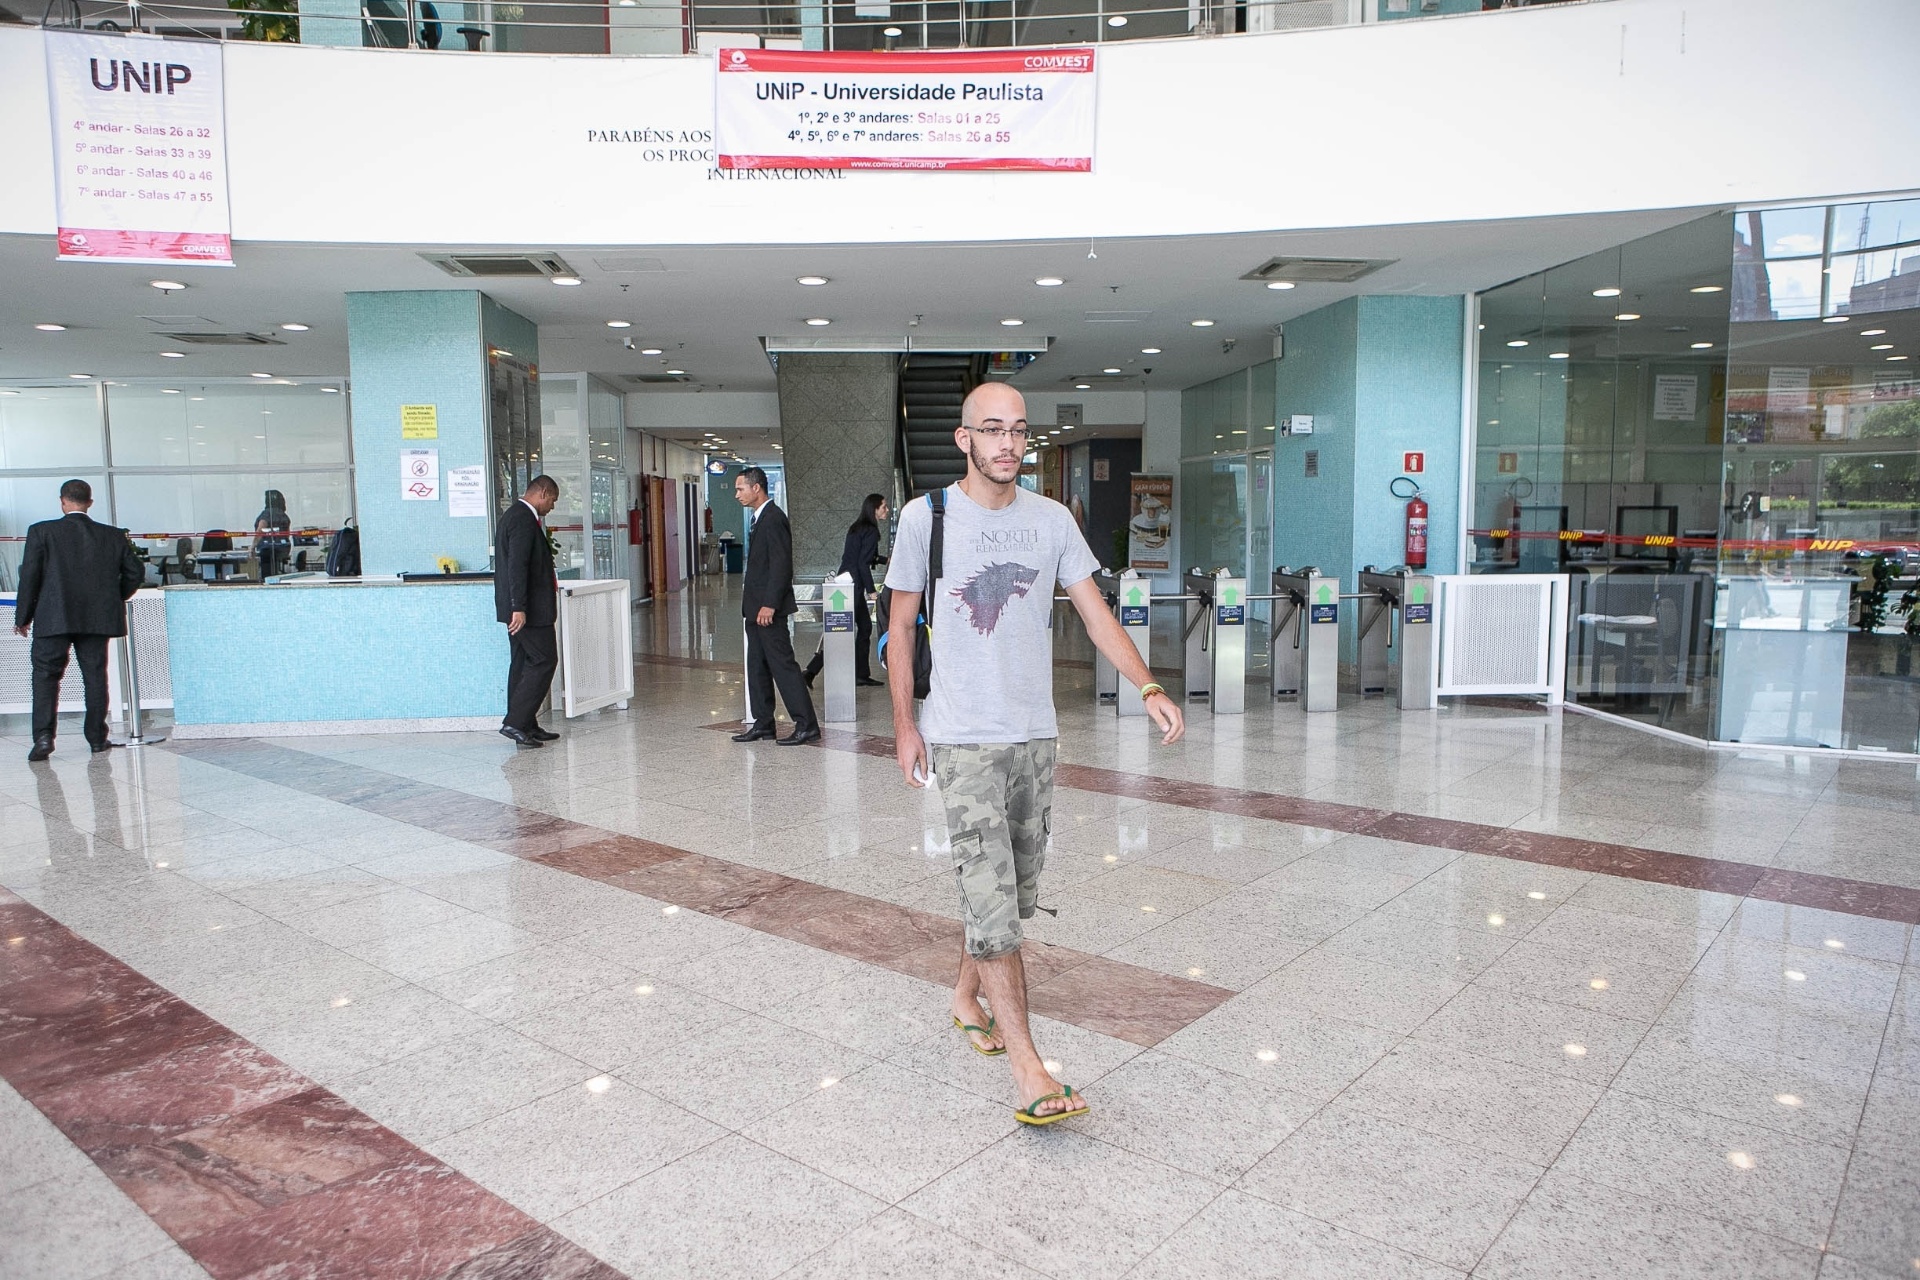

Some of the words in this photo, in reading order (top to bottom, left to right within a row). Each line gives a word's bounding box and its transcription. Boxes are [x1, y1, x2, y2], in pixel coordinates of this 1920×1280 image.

[1024, 56, 1090, 67] COMVEST
[90, 58, 192, 95] UNIP
[756, 82, 804, 100] UNIP
[824, 82, 956, 100] Universidade
[962, 82, 1044, 100] Paulista
[798, 112, 813, 125] 1º,
[816, 112, 829, 123] 2º
[832, 114, 840, 123] e
[843, 112, 856, 123] 3º
[859, 112, 914, 124] andares:
[918, 112, 952, 124] Salas
[956, 113, 970, 124] 01
[974, 115, 982, 124] a
[986, 113, 1000, 124] 25
[74, 120, 85, 130] 4º
[88, 122, 124, 133] andar
[134, 124, 166, 136] Salas
[170, 126, 184, 136] 26
[186, 129, 194, 137] a
[196, 128, 210, 138] 32
[588, 127, 674, 142] PARABÉNS
[678, 130, 712, 142] AOS
[788, 130, 804, 143] 4º,
[807, 130, 823, 143] 5º,
[827, 130, 840, 141] 6º
[842, 133, 850, 142] e
[853, 130, 866, 141] 7º
[869, 130, 924, 142] andares:
[928, 130, 962, 142] Salas
[966, 131, 981, 142] 26
[984, 134, 992, 142] a
[995, 132, 1011, 142] 55
[75, 142, 86, 153] 5º
[90, 144, 124, 155] andar
[135, 146, 168, 157] Salas
[171, 148, 184, 158] 33
[188, 151, 195, 159] a
[198, 149, 212, 159] 39
[643, 149, 664, 162] OS
[850, 160, 948, 169] www.comvest.unicamp.br
[76, 164, 88, 175] 6º
[92, 166, 126, 177] andar
[136, 168, 169, 179] Salas
[172, 170, 186, 180] 40
[189, 173, 196, 181] a
[198, 171, 213, 181] 46
[707, 168, 846, 180] INTERNACIONAL
[78, 186, 90, 197] 7º
[93, 188, 127, 198] andar
[138, 190, 170, 201] Salas
[173, 192, 186, 201] 47
[190, 194, 197, 202] a
[200, 193, 213, 202] 55
[182, 244, 226, 254] COMVEST
[981, 530, 1038, 544] NORTH
[1490, 529, 1510, 538] UNIP
[1559, 531, 1583, 541] UNIP
[976, 543, 1034, 552] REMEMBERS
[1644, 536, 1674, 546] UNIP
